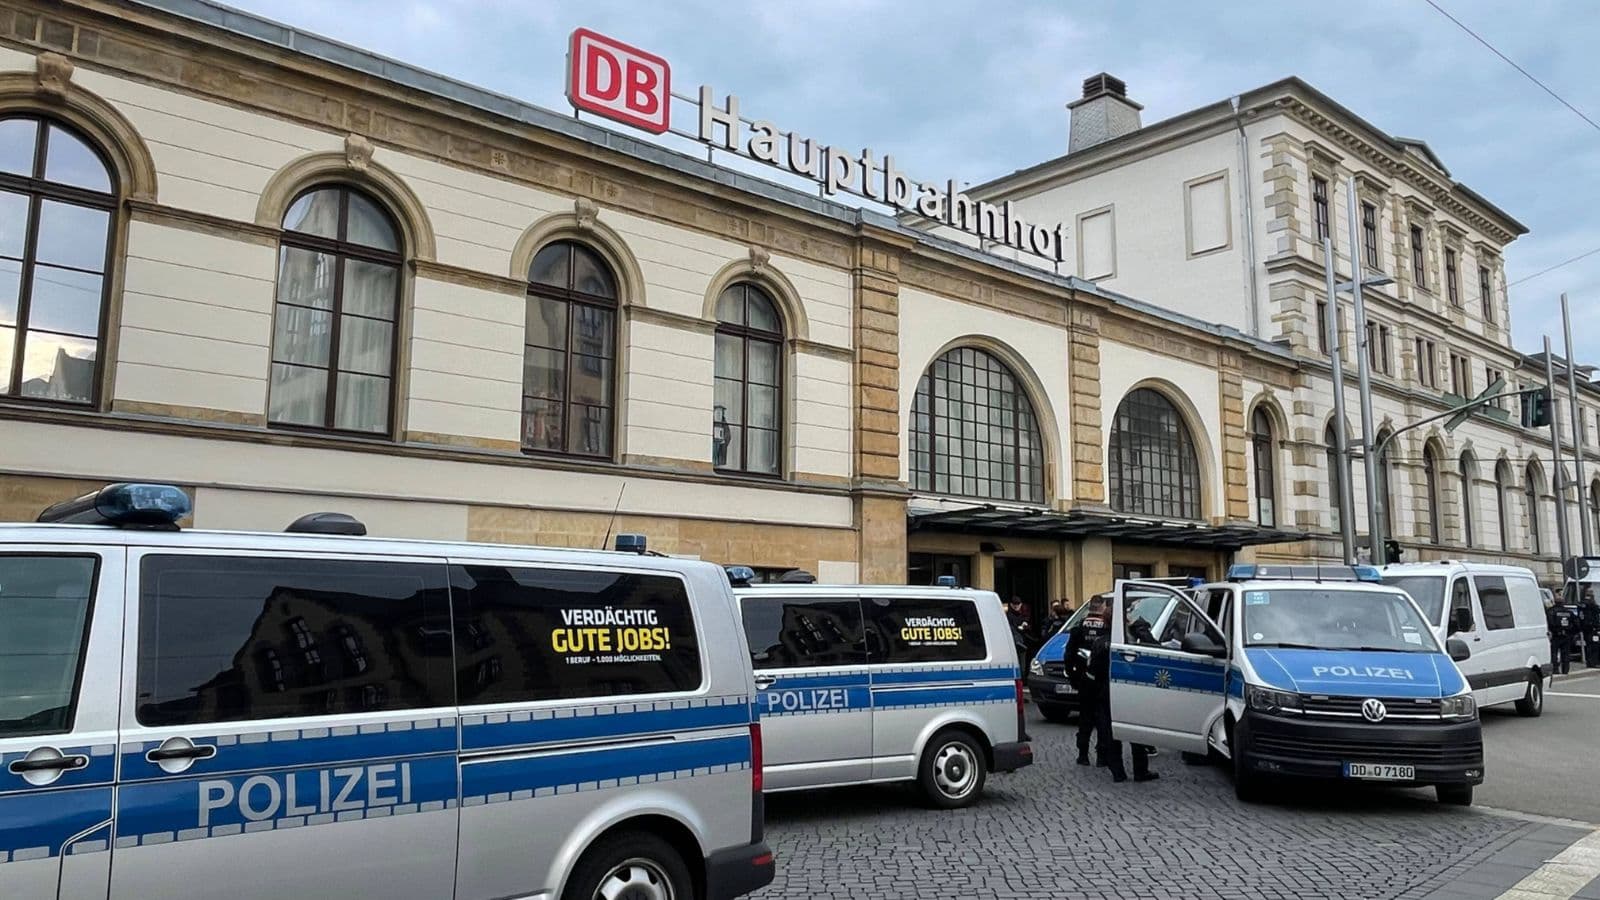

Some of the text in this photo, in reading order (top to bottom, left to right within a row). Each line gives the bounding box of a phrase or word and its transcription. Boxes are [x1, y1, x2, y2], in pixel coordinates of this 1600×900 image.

[586, 44, 658, 115] DB
[699, 84, 1064, 263] Hauptbahnhof
[561, 606, 658, 625] VERDÄCHTIG
[904, 616, 956, 627] VERDÄCHTIG
[1082, 619, 1104, 628] POLIZEI
[552, 627, 671, 653] GUTE JOBS!
[901, 627, 963, 641] GUTE JOBS!
[570, 656, 591, 664] BERUF
[1312, 665, 1414, 680] POLIZEI
[767, 689, 849, 711] POLIZEI
[1351, 764, 1366, 776] DD
[1384, 766, 1413, 778] 7180
[198, 762, 411, 827] POLIZEI
